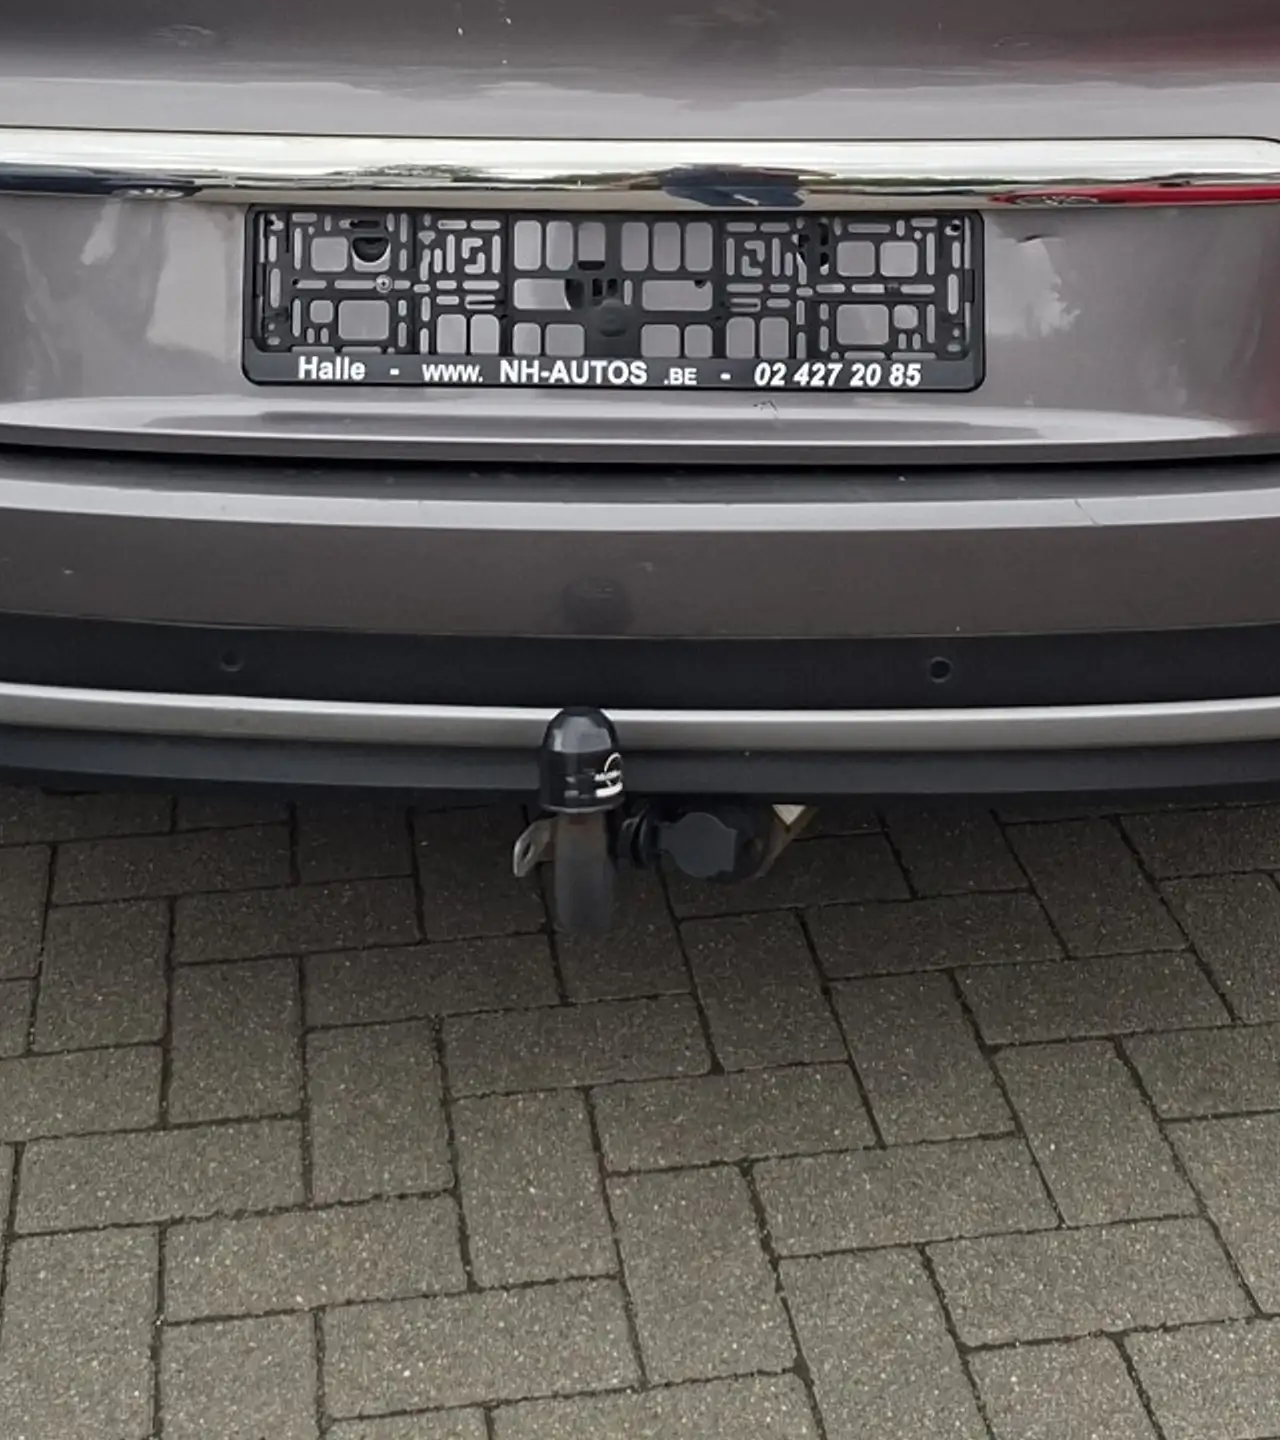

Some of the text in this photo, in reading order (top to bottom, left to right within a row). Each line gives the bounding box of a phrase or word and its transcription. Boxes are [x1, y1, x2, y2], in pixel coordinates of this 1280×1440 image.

[297, 355, 366, 381] Halle
[421, 363, 484, 384] www.
[499, 359, 648, 385] NH-AUTOS
[663, 367, 698, 386] .BE
[753, 362, 786, 387] 02
[792, 362, 843, 387] 427
[849, 363, 882, 387] 20
[888, 363, 921, 388] 85
